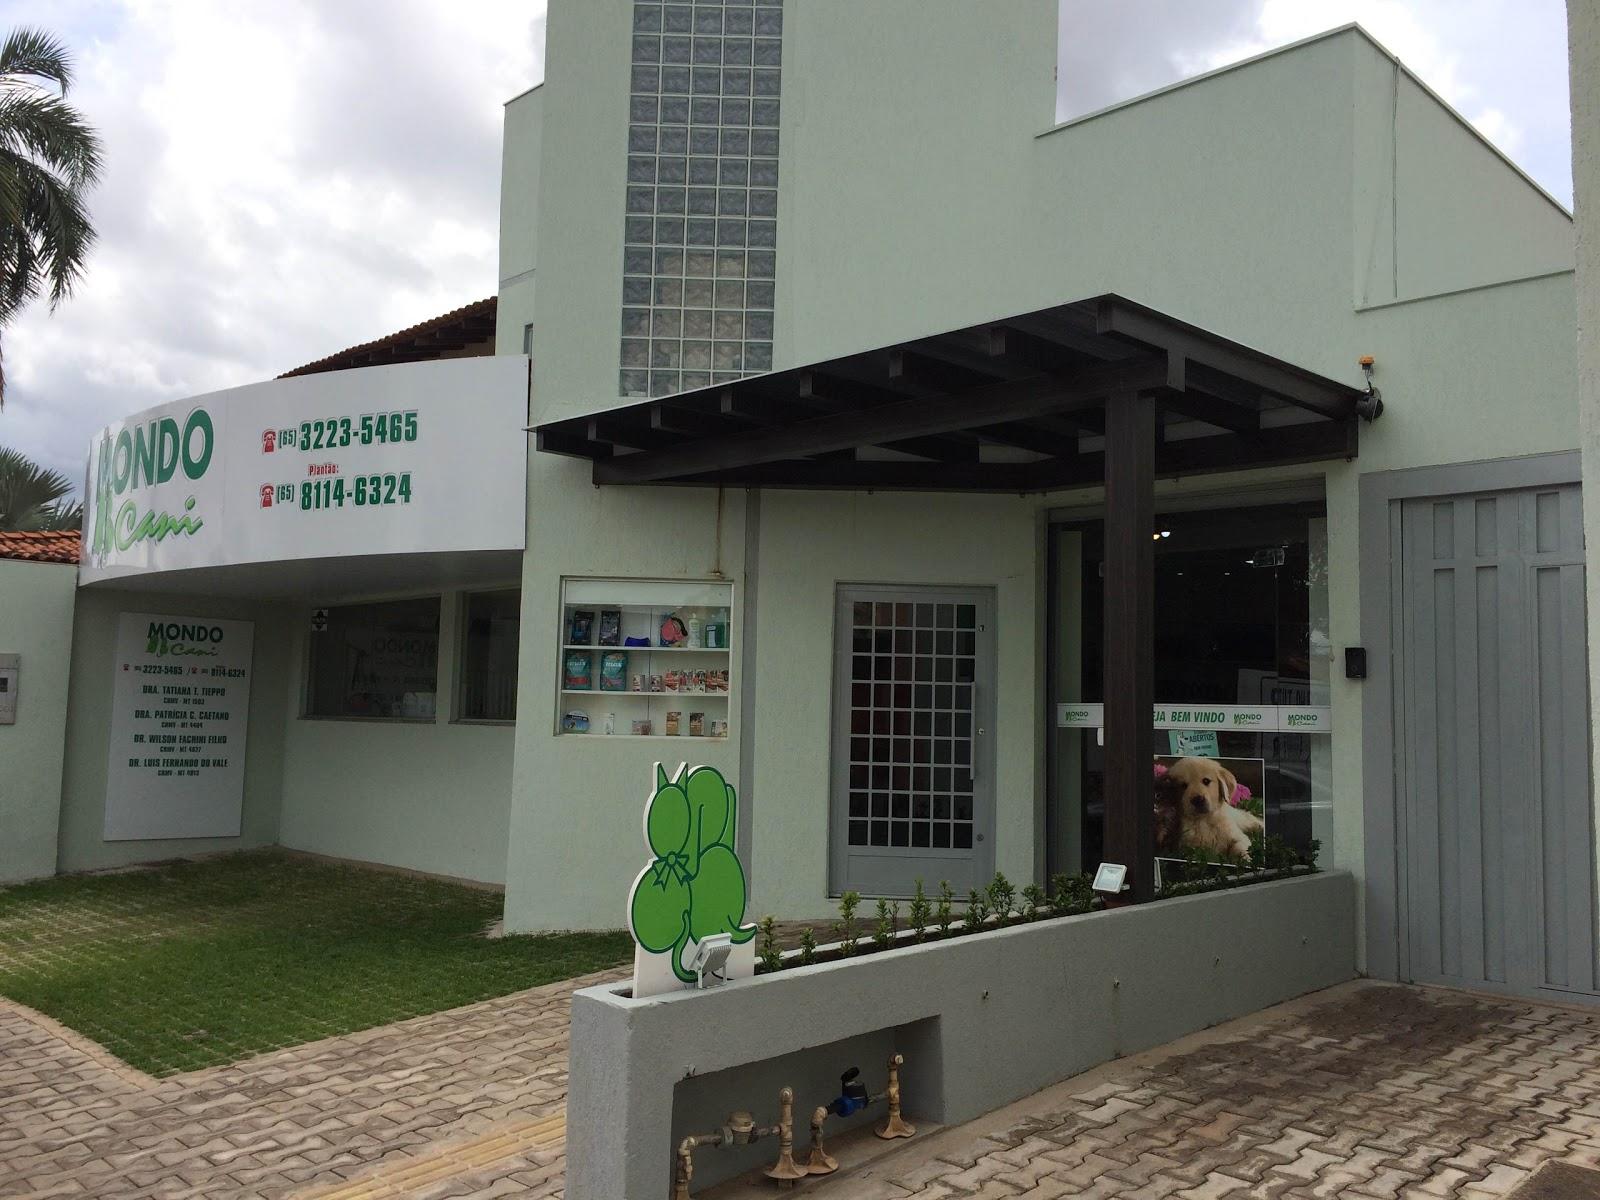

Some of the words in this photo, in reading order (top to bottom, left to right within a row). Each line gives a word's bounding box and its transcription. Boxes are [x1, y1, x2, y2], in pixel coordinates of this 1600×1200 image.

[279, 429, 297, 449] (65)
[301, 411, 418, 451] 3223-5465
[277, 484, 295, 504] (65)
[301, 474, 412, 511] 8114-6324
[114, 495, 204, 552] Cani
[147, 622, 224, 643] MONDO
[163, 686, 191, 696] TATIANA
[199, 711, 229, 721] CAETANO
[1171, 711, 1191, 722] BEM
[1194, 711, 1226, 723] VINDO
[1233, 713, 1262, 721] MONDO
[149, 735, 177, 744] WILSON
[144, 759, 160, 768] LUIS
[162, 758, 199, 768] FERNANDO
[201, 758, 210, 767] DO
[213, 759, 228, 767] VALE
